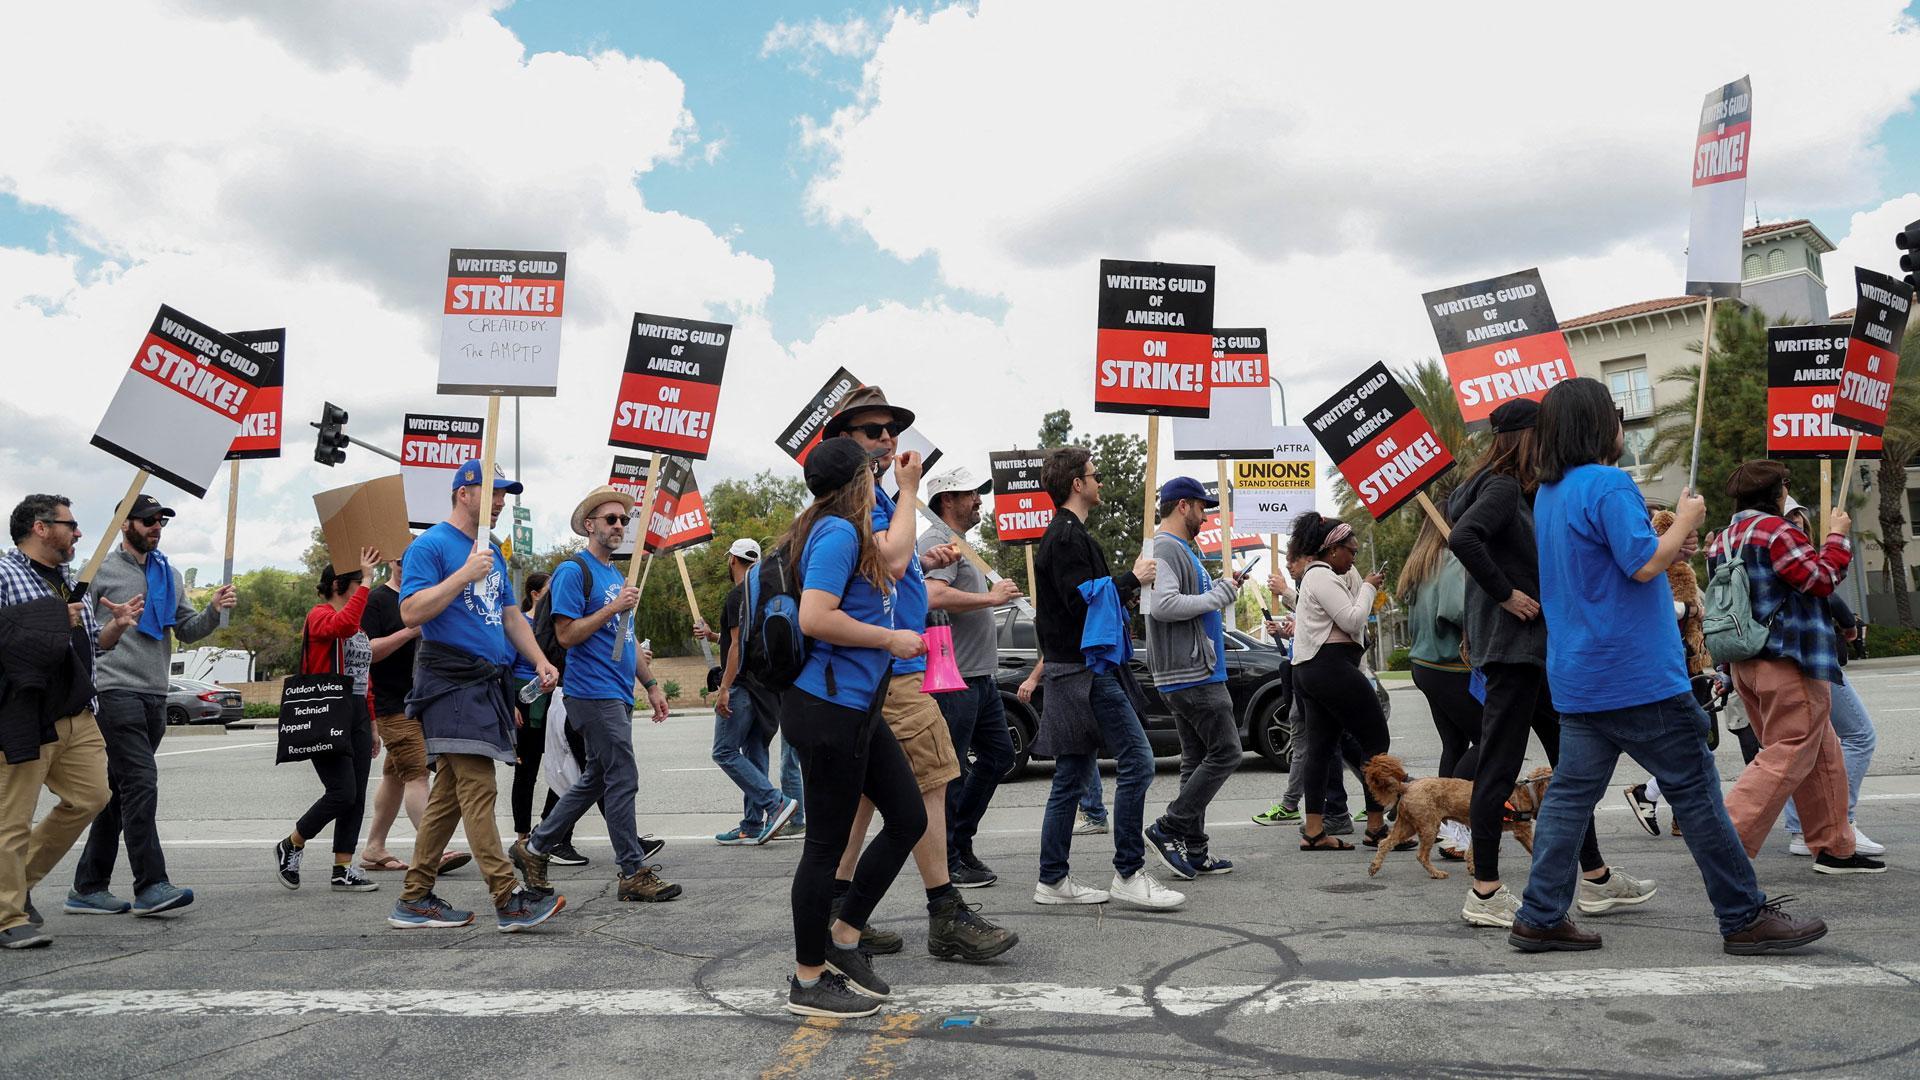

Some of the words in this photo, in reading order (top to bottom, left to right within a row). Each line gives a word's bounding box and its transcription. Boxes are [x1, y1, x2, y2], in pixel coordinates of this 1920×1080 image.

[1728, 94, 1748, 116] GUILD
[1718, 123, 1725, 135] ON
[1696, 132, 1745, 179] STRIKE!
[457, 259, 516, 272] WRITERS
[519, 260, 558, 274] GUILD
[500, 275, 512, 283] ON
[1107, 275, 1166, 291] WRITERS
[1169, 278, 1206, 293] GUILD
[452, 284, 555, 312] STRIKE!
[1149, 295, 1163, 307] OF
[1433, 292, 1496, 316] WRITERS
[1496, 284, 1536, 303] GUILD
[1860, 283, 1891, 306] WRITERS
[1891, 293, 1908, 313] GUILD
[1125, 310, 1185, 326] AMERICA
[1484, 309, 1497, 321] OF
[1879, 310, 1887, 321] OF
[468, 318, 528, 333] CREATED
[1466, 319, 1528, 343] AMERICA
[1865, 322, 1892, 345] AMERICA
[638, 323, 688, 341] WRITERS
[690, 331, 725, 346] GUILD
[1228, 336, 1260, 348] GUILD
[160, 317, 221, 358] WRITERS
[220, 349, 260, 377] GUILD
[462, 343, 483, 358] The
[490, 342, 542, 363] AMPTP
[671, 345, 684, 356] OF
[1144, 340, 1166, 357] ON
[1774, 339, 1832, 352] WRITERS
[196, 354, 211, 367] ON
[1494, 348, 1520, 366] ON
[1816, 354, 1829, 365] OF
[1868, 355, 1880, 373] ON
[647, 357, 700, 376] AMERICA
[1211, 360, 1263, 383] RIKE!
[141, 345, 248, 415] STRIKE!
[1101, 360, 1204, 393] STRIKE!
[1459, 359, 1568, 406] STRIKE!
[1794, 369, 1843, 382] AMERIC
[659, 386, 680, 403] ON
[1840, 371, 1890, 411] STRIKE!
[1313, 394, 1359, 432] WRITERS
[1357, 373, 1388, 399] GUILD
[1812, 394, 1834, 408] ON
[617, 401, 710, 439] STRIKE!
[786, 405, 827, 450] WRITERS
[824, 379, 851, 409] GUILD
[1354, 407, 1367, 421] OF
[409, 418, 449, 432] WRITERS
[451, 420, 479, 433] GUILD
[1346, 408, 1393, 447] AMERICA
[1772, 414, 1872, 437] STRI
[405, 441, 476, 464] STRIKE!
[1376, 437, 1398, 458] ON
[615, 464, 639, 475] WRITERS
[994, 460, 1027, 469] WRITERS
[1028, 458, 1045, 467] GUIL
[1239, 463, 1310, 478] UNIONS
[1359, 432, 1441, 504] STRIKE!
[1008, 480, 1040, 490] AMERICA
[1019, 499, 1032, 508] ON
[1259, 503, 1288, 512] WGA
[999, 510, 1053, 530] STRIKE!
[285, 685, 315, 696] Outdoor
[317, 683, 343, 692] Voices
[294, 704, 329, 716] Technical
[280, 721, 311, 733] Apparel
[330, 728, 343, 737] for
[288, 743, 333, 754] Recreation
